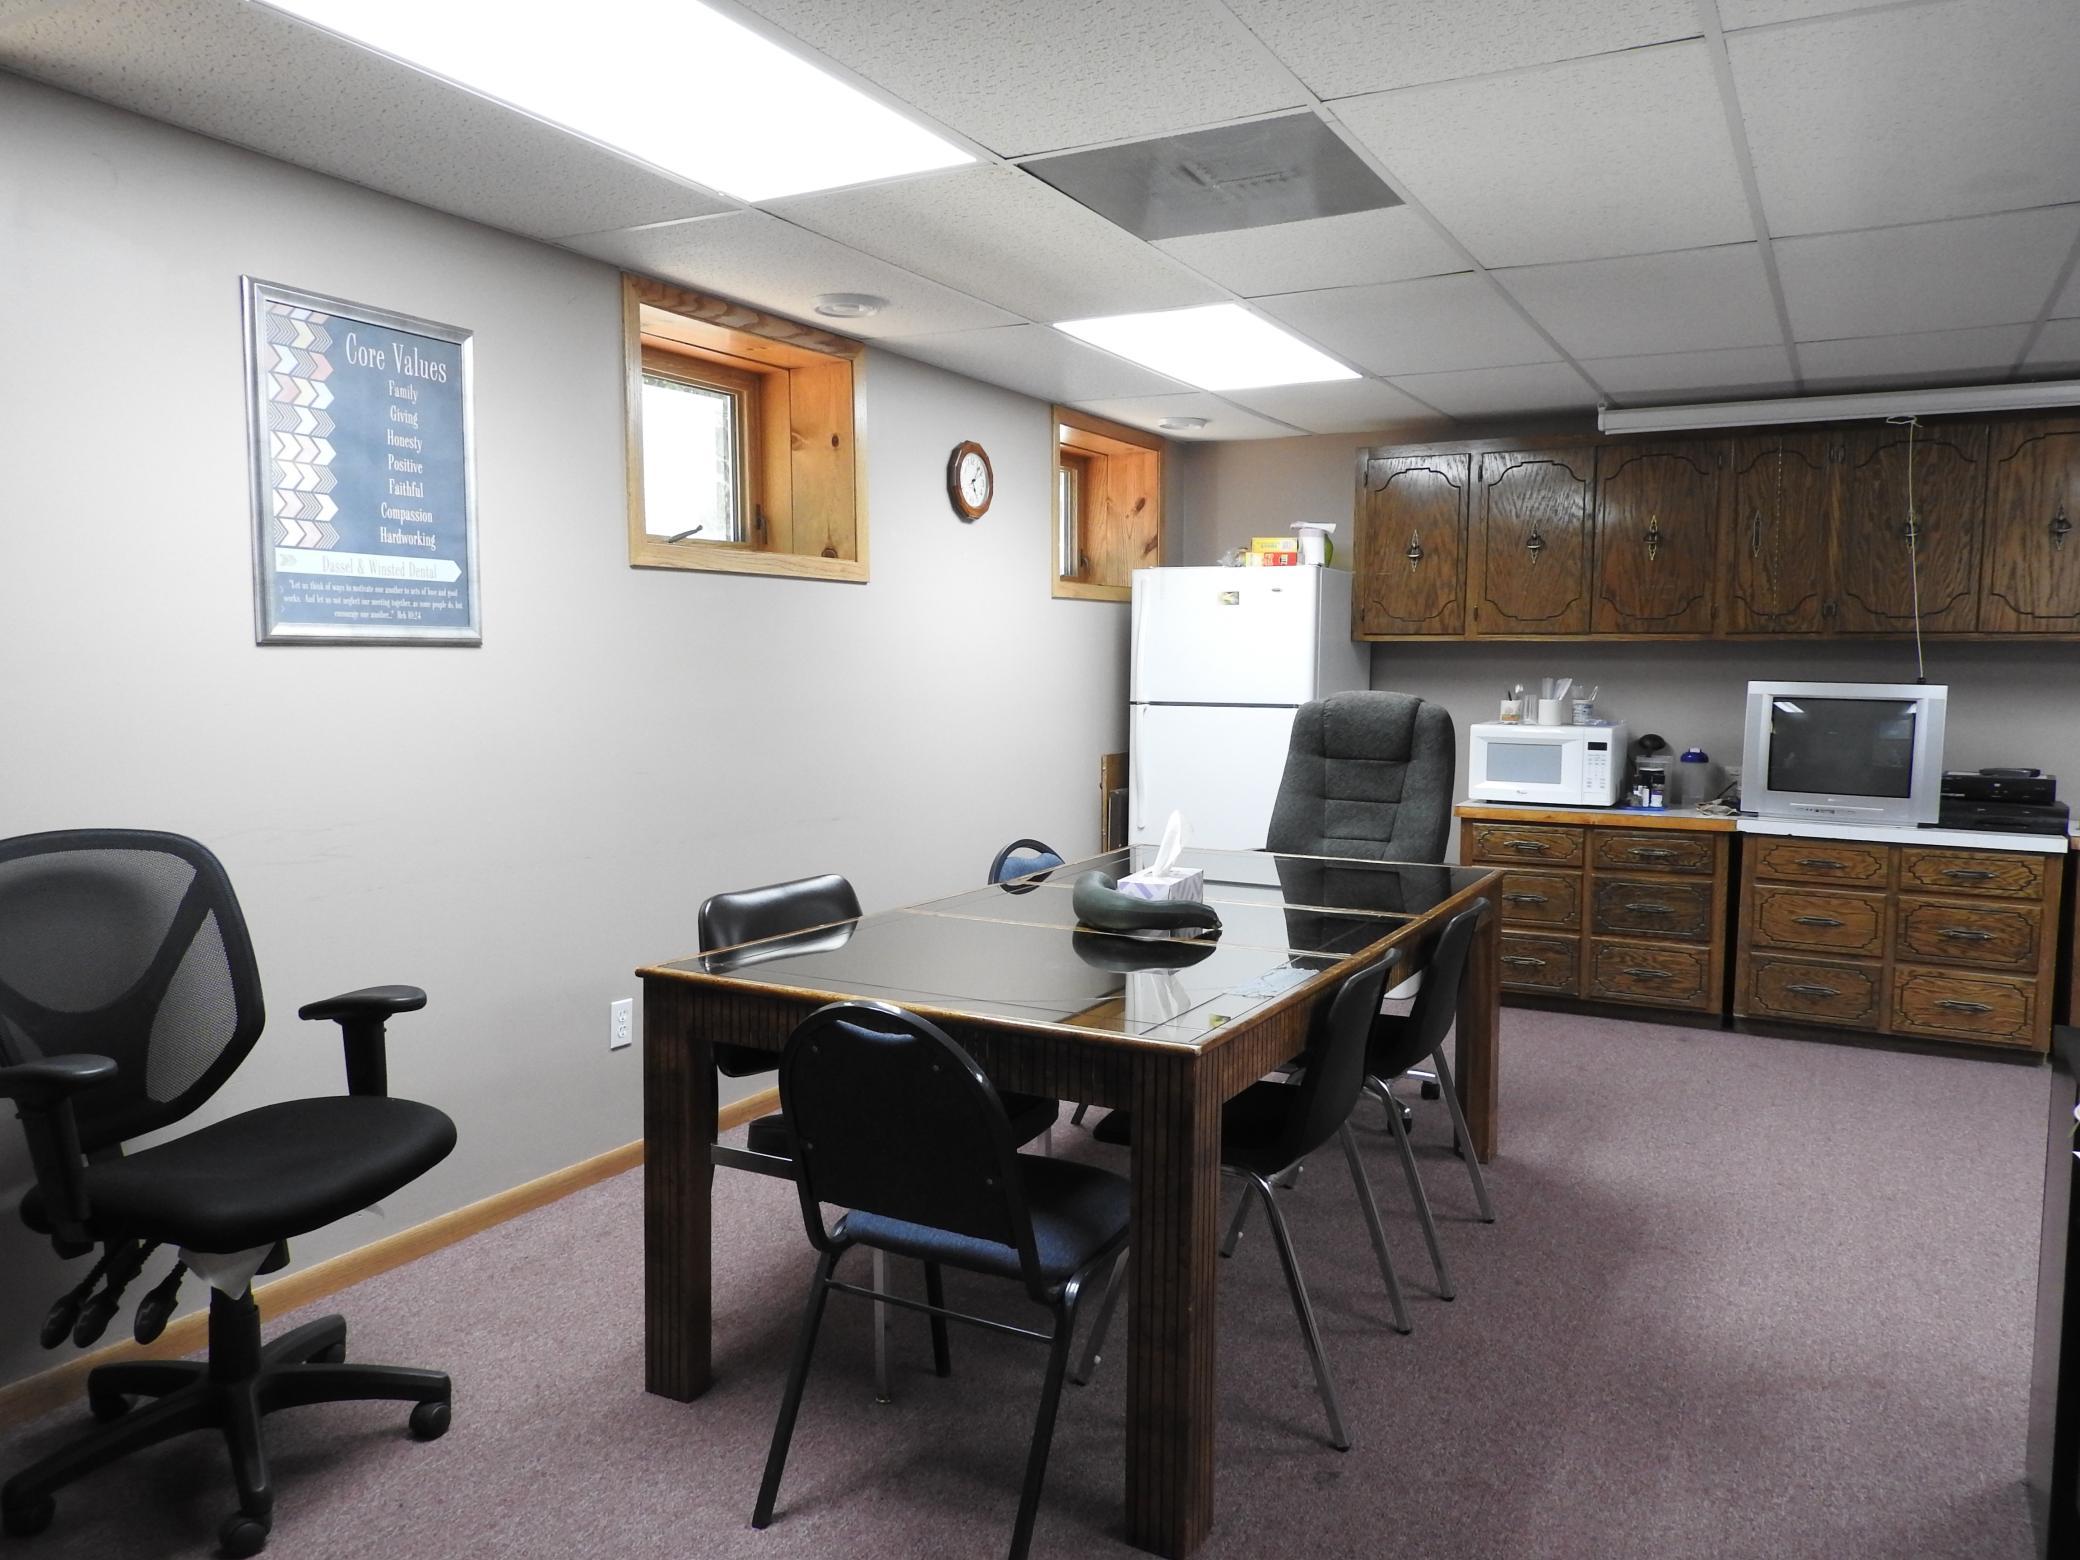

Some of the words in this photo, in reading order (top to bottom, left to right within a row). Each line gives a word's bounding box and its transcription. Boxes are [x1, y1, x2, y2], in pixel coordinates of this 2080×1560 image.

[345, 332, 385, 370] Core
[392, 342, 447, 383] Values
[388, 379, 417, 405] Family
[390, 405, 419, 429] Giving
[387, 428, 423, 454] Honesty
[388, 453, 423, 474] Positive
[388, 478, 424, 498] Faithful
[381, 502, 433, 525] Compassion
[380, 526, 437, 551] Hardworking
[322, 555, 353, 574] Dassel
[357, 558, 365, 574] &
[369, 559, 405, 577] Winsted
[408, 561, 438, 579] Dental
